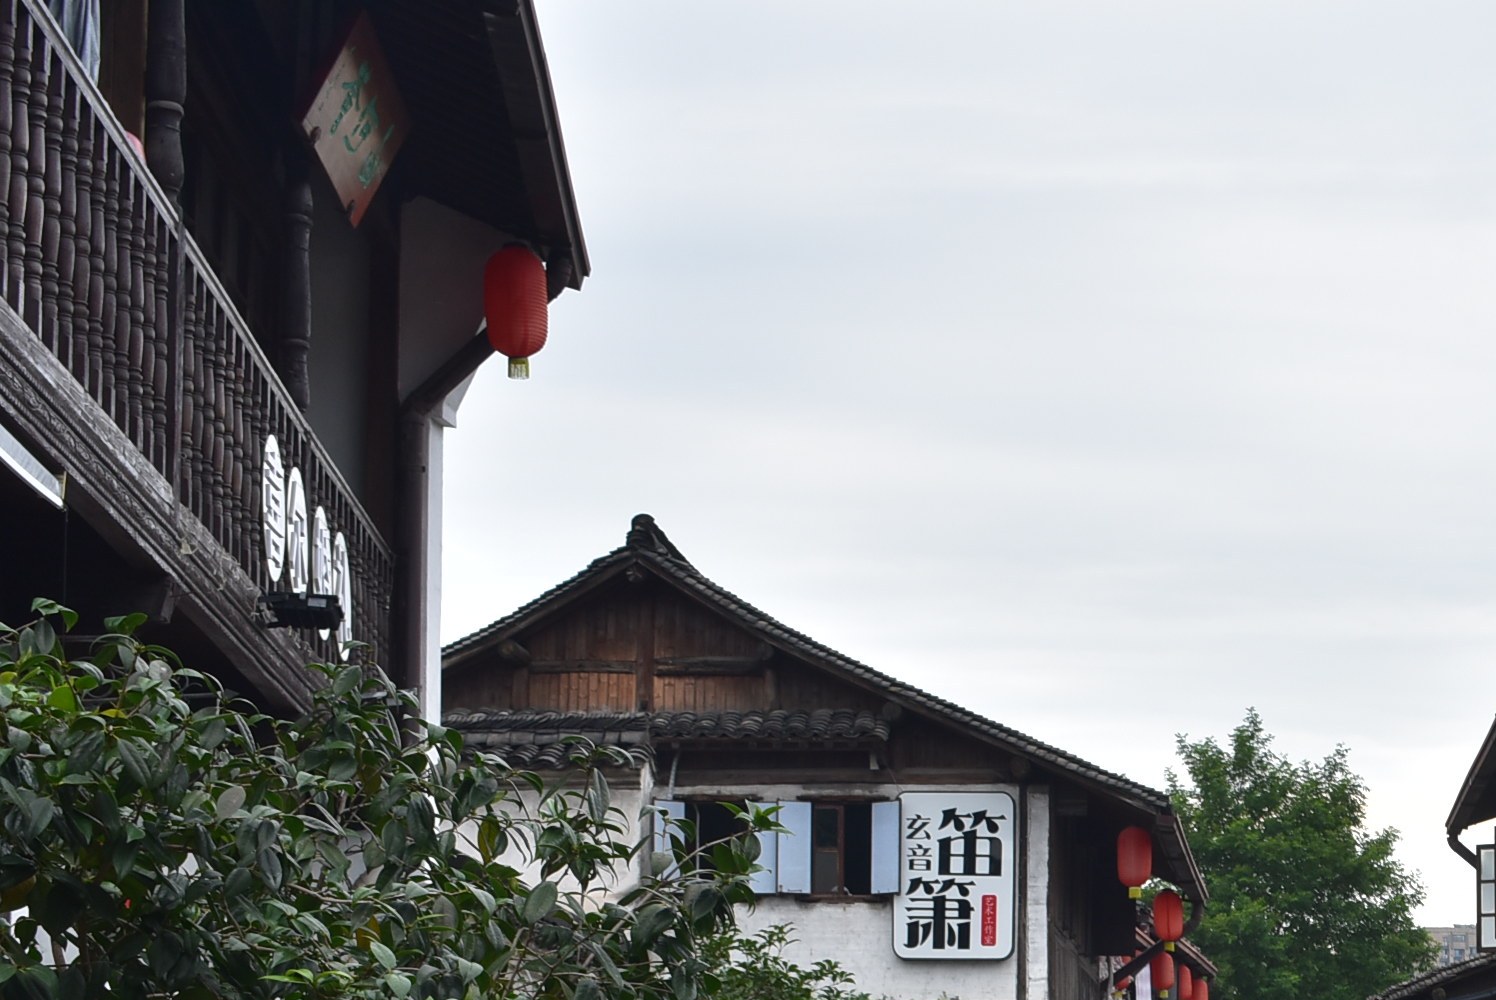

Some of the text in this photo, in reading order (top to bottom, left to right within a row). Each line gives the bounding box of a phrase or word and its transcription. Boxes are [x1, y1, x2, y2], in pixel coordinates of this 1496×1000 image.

[906, 814, 932, 871] 玄音
[984, 897, 994, 944] 艺术工作室
